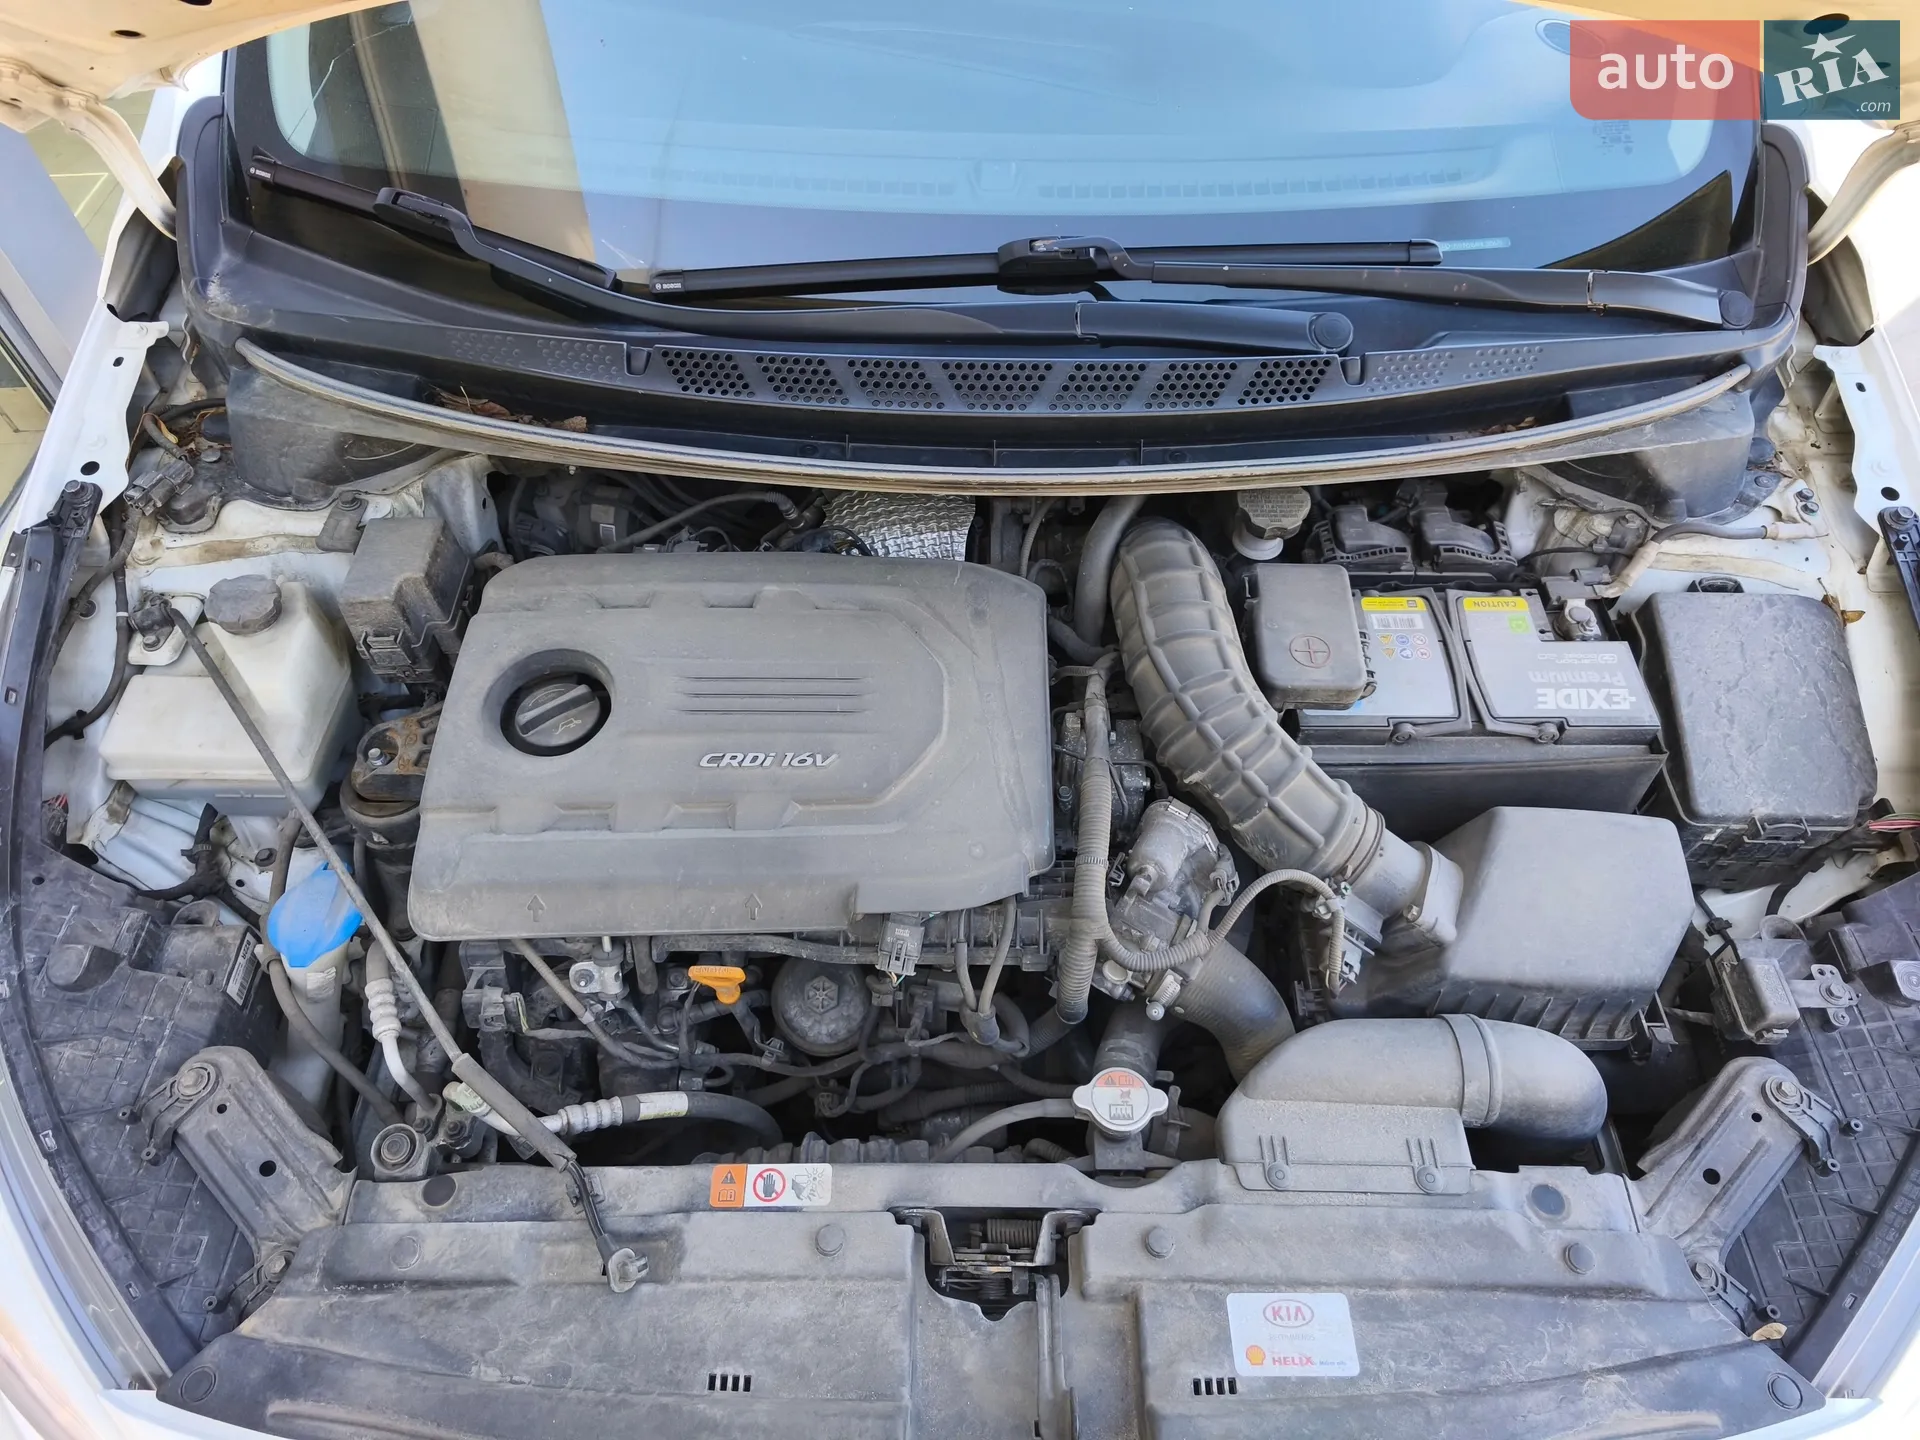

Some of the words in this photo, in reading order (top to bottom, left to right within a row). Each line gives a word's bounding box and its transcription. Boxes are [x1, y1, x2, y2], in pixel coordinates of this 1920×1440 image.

[1473, 600, 1517, 608] CAUTION
[1528, 671, 1627, 687] Premium
[1535, 688, 1636, 710] EXIDE
[699, 752, 777, 768] CRDi
[1271, 1305, 1307, 1322] KIA
[1272, 1356, 1315, 1367] HELIX
